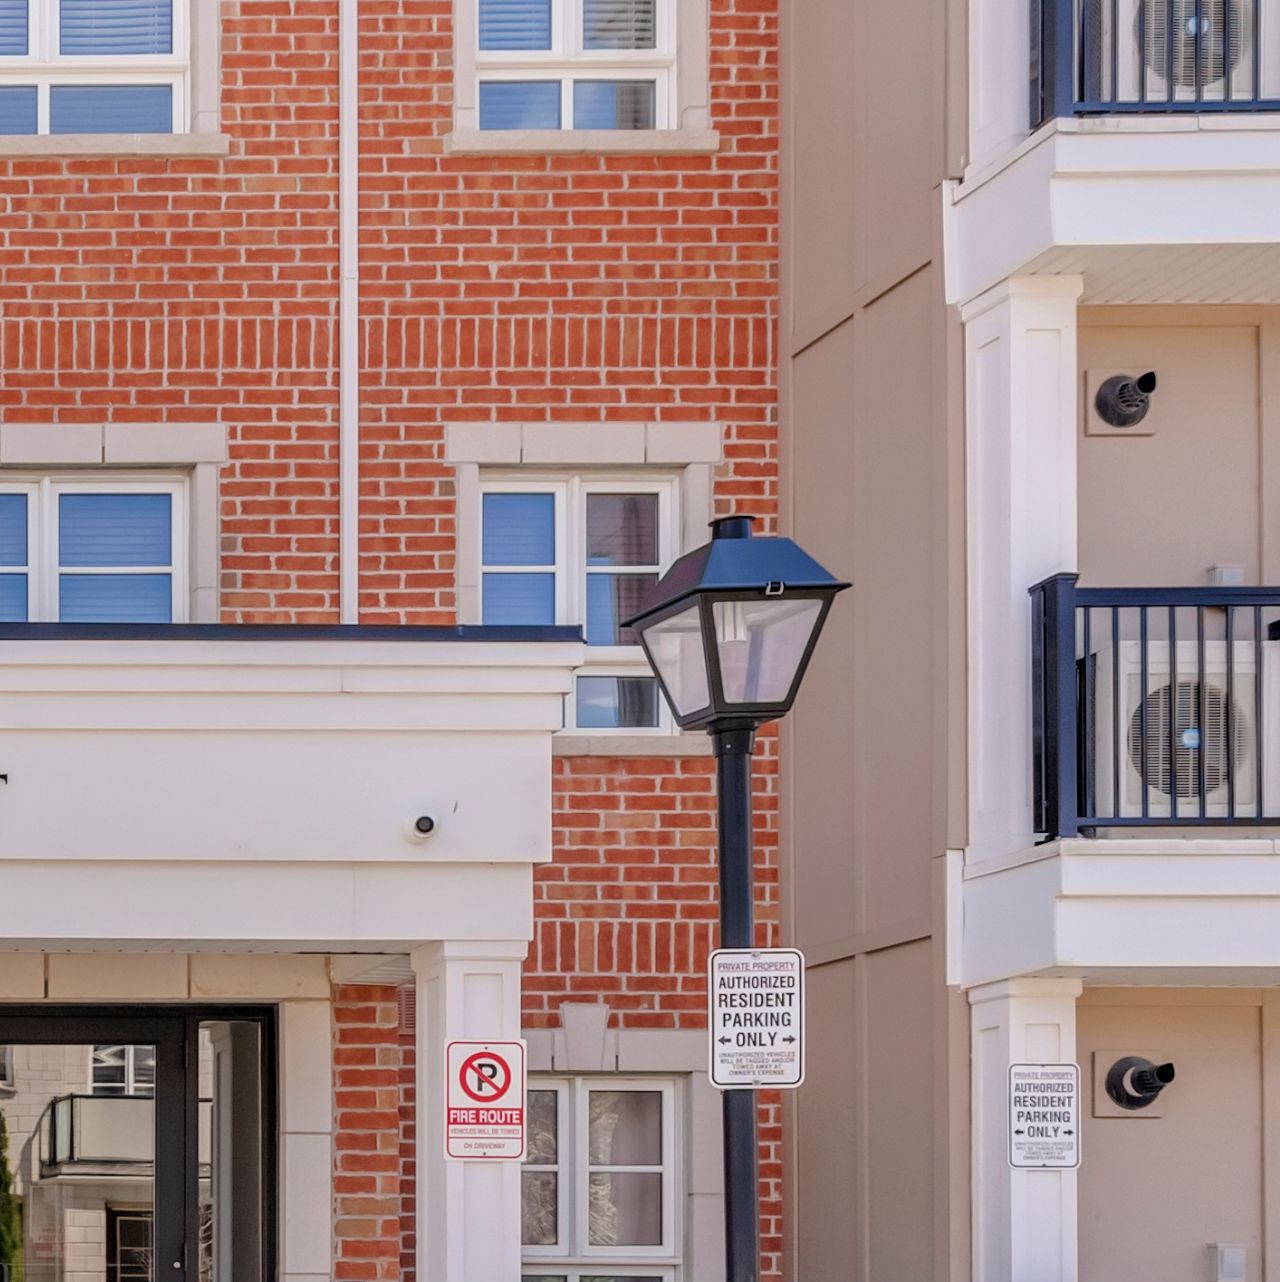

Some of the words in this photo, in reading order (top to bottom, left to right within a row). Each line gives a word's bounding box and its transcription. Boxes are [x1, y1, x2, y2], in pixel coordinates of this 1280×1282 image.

[718, 963, 750, 971] PRIVATE
[753, 962, 795, 970] PROPERTY
[719, 976, 795, 989] AUTHORIZED
[718, 992, 795, 1008] RESIDENT
[723, 1012, 791, 1027] PARKING
[736, 1032, 777, 1047] ONLY
[1014, 1083, 1074, 1093] AUTHORIZED
[1014, 1096, 1074, 1107] RESIDENT
[450, 1110, 476, 1123] FIRE
[479, 1110, 520, 1123] ROUTE
[1017, 1111, 1071, 1122] PARKING
[1028, 1126, 1060, 1138] ONLY
